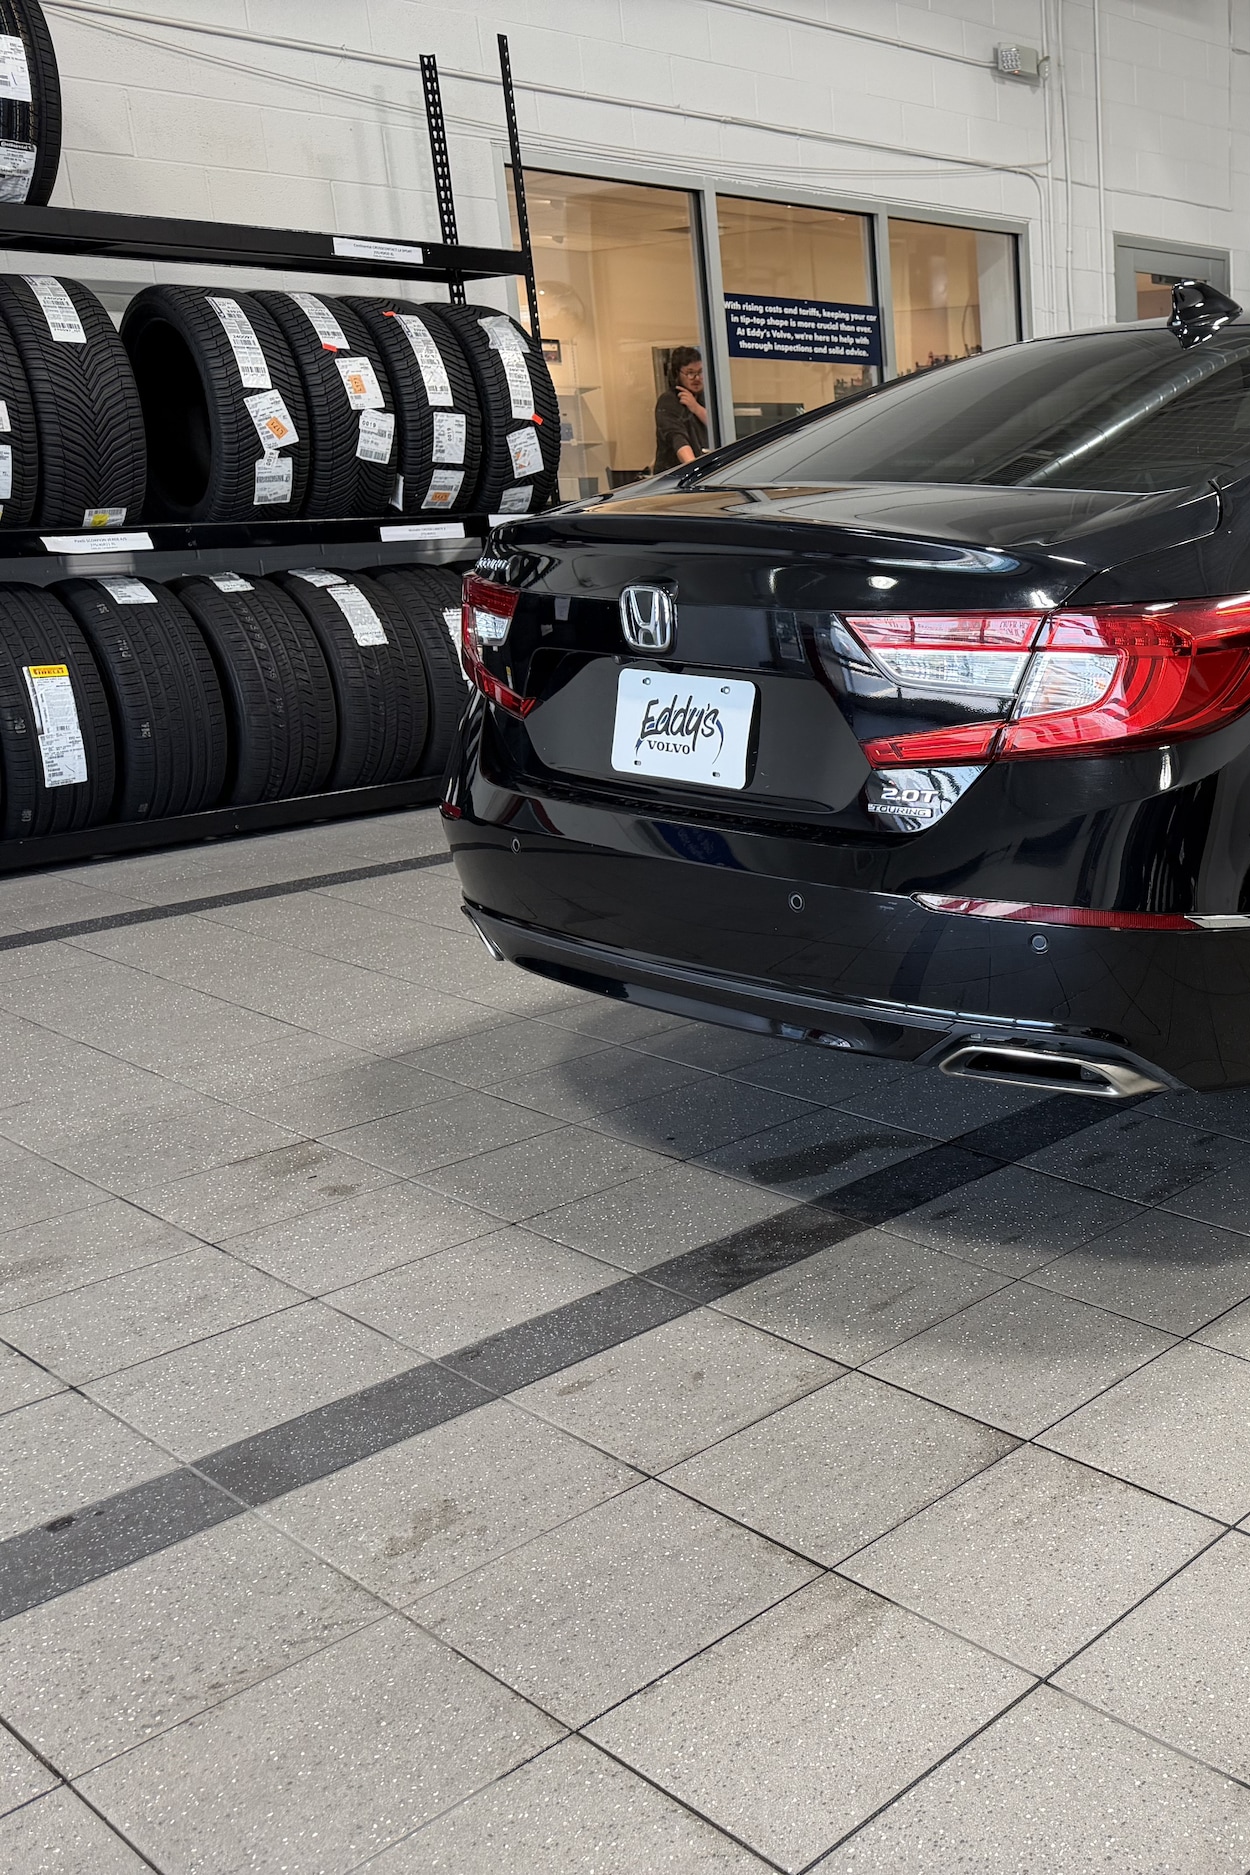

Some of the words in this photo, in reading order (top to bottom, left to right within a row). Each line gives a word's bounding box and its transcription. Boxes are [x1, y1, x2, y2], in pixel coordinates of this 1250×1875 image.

[724, 301, 741, 310] With
[742, 303, 764, 314] rising
[765, 305, 782, 313] costs
[784, 306, 797, 315] and
[799, 308, 821, 318] tariffs,
[823, 309, 850, 321] keeping
[851, 314, 865, 322] your
[731, 314, 739, 323] in
[740, 315, 765, 326] tip-top
[767, 317, 788, 327] shape
[790, 319, 796, 327] is
[817, 322, 838, 330] crucial
[840, 323, 855, 331] than
[736, 327, 745, 335] At
[747, 328, 770, 339] Eddy's
[772, 330, 794, 340] Volvo,
[795, 332, 813, 340] we're
[814, 333, 830, 342] here
[839, 335, 854, 345] help
[855, 336, 870, 345] with
[739, 340, 773, 352] thorough
[774, 343, 812, 353] inspections
[814, 345, 827, 354] and
[829, 346, 844, 355] solid
[846, 348, 869, 357] advice.
[640, 694, 719, 752] Eddy's
[647, 740, 691, 755] VOLVO
[880, 787, 939, 803] 2.0T
[873, 804, 927, 817] TOURING
